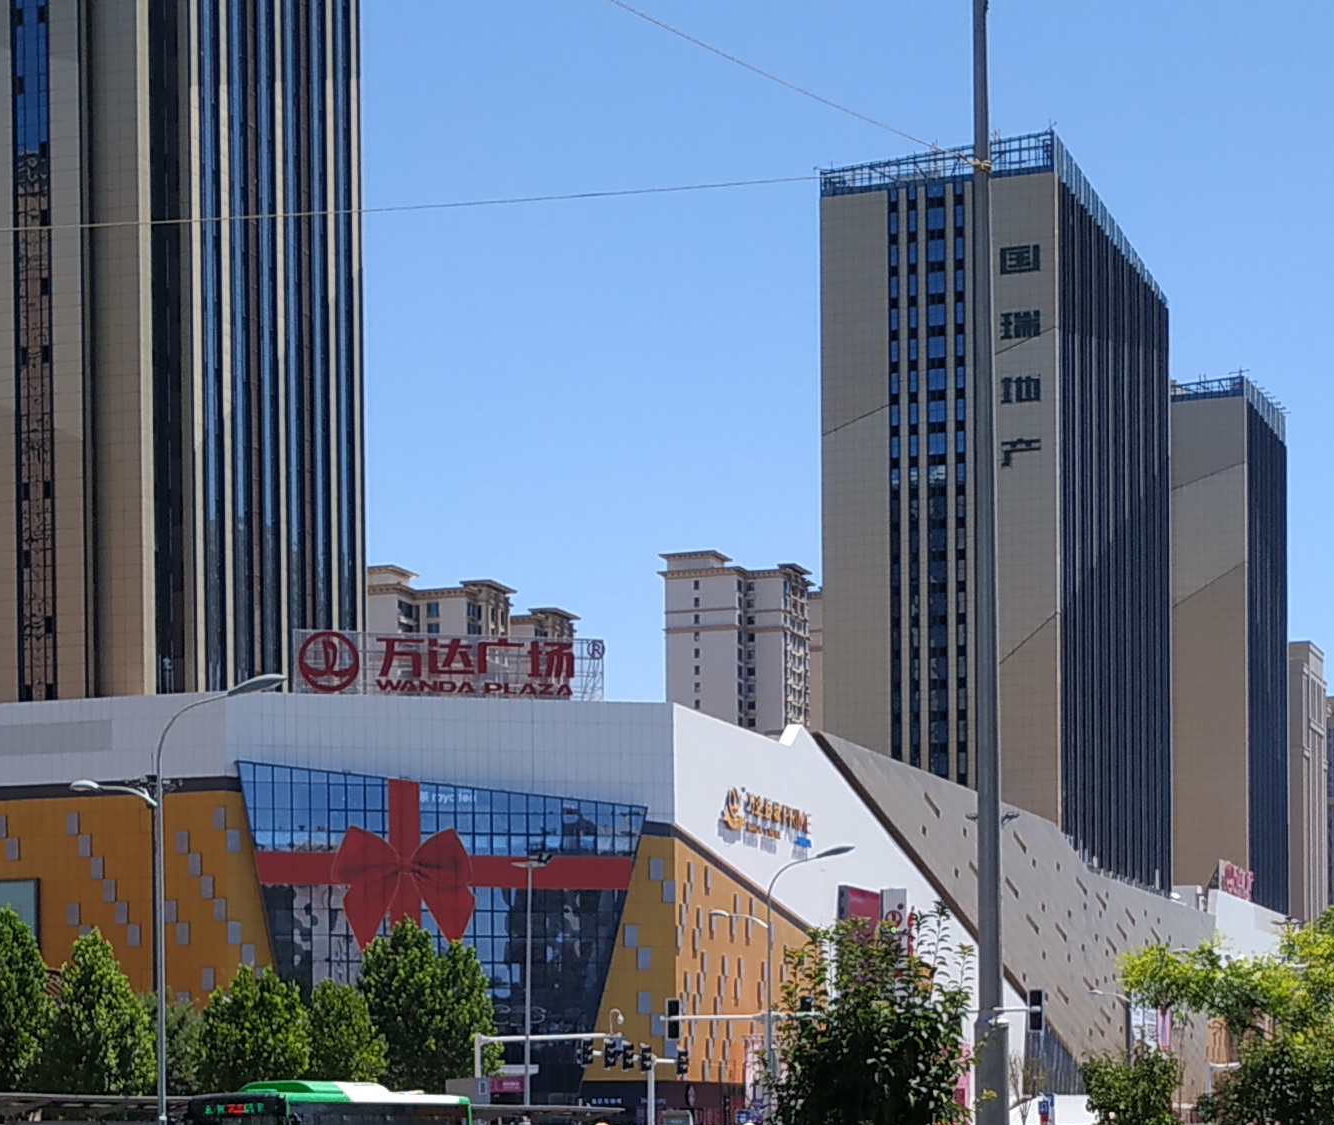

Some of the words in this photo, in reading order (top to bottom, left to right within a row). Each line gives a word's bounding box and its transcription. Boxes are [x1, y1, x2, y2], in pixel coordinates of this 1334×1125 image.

[1000, 244, 1042, 468] 国瑞地产
[376, 637, 575, 679] 万达广场
[375, 679, 476, 694] WANDA
[483, 682, 574, 697] PLAZA
